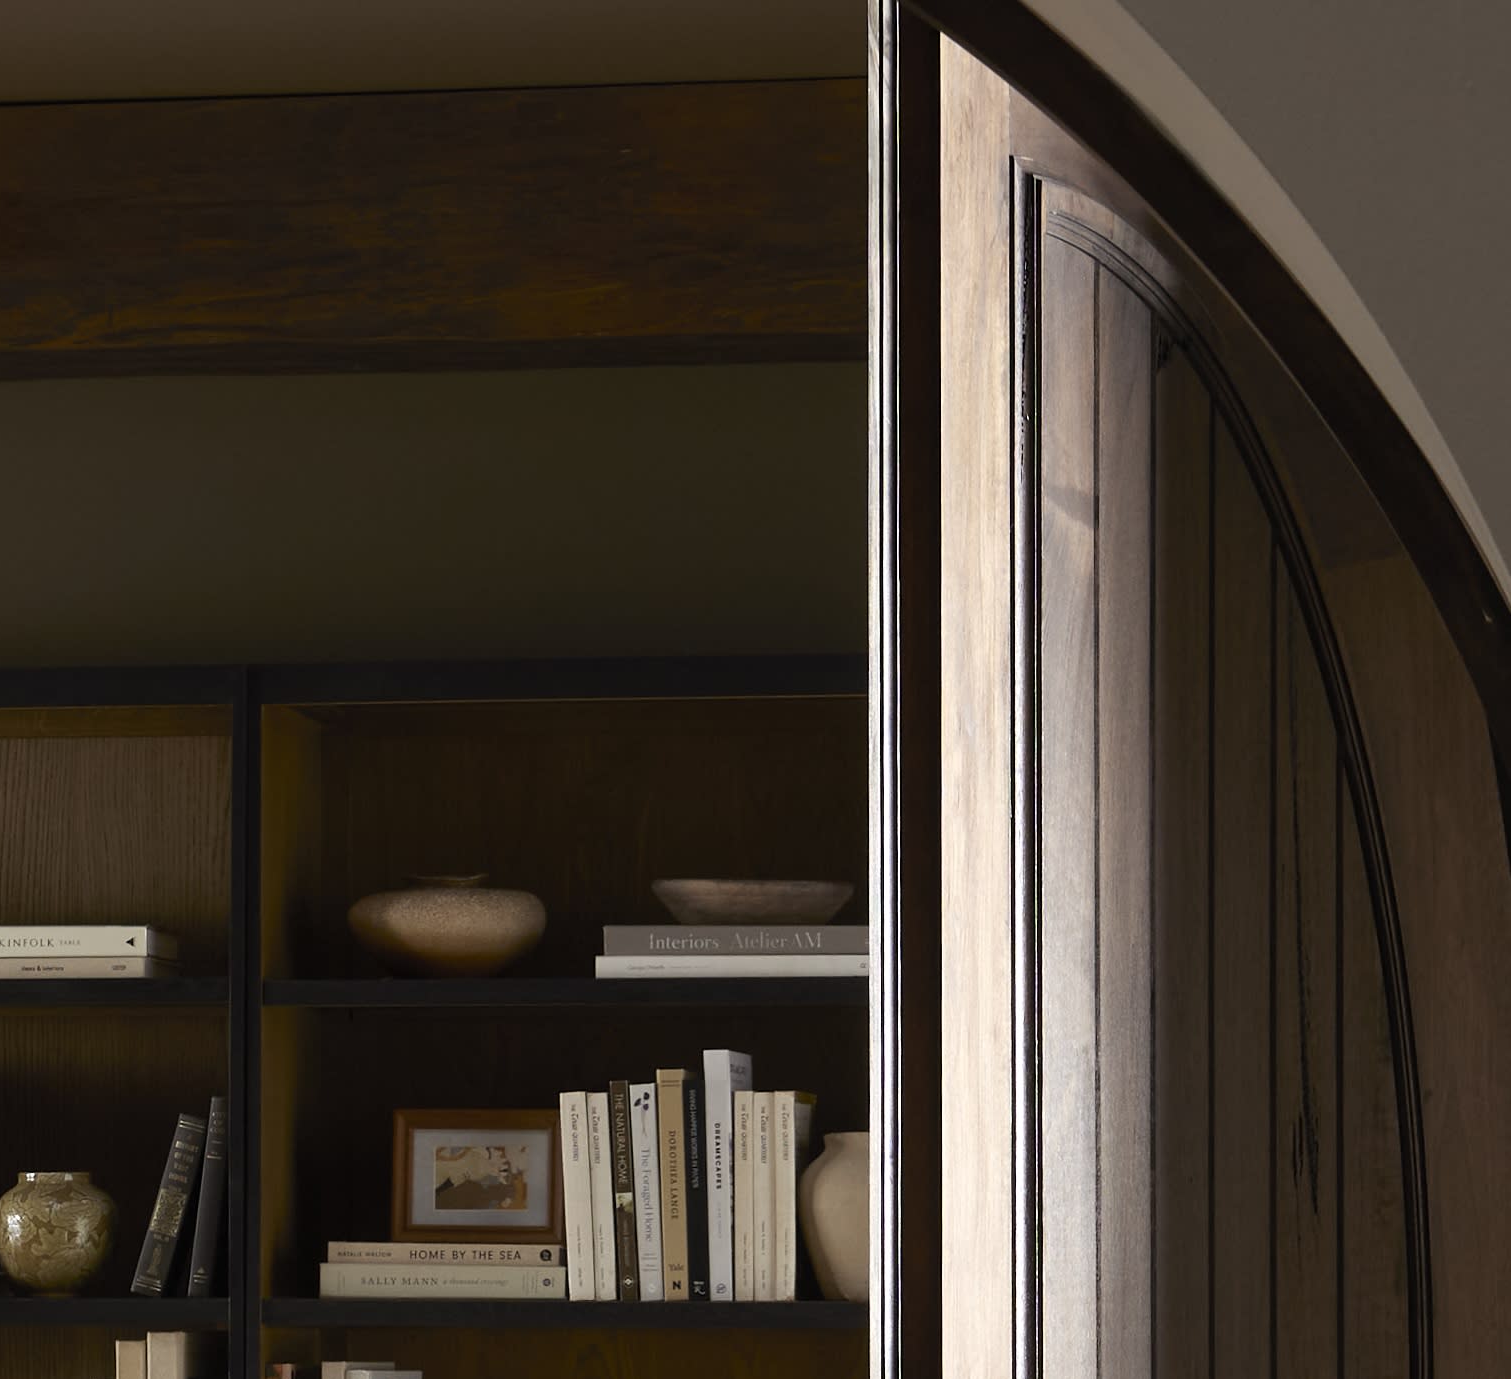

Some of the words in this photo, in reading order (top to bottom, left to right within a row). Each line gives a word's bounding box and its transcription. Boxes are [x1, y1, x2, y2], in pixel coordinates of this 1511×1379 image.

[648, 932, 720, 951] Interiors
[731, 932, 788, 951] Atelier
[615, 1093, 625, 1109] THE
[616, 1112, 627, 1155] NATURAL
[640, 1148, 651, 1166] The
[669, 1129, 678, 1185] DOROTHEA
[690, 1138, 698, 1159] WORKS
[713, 1122, 722, 1190] DREAMSCAPES
[618, 1156, 629, 1185] HOME
[691, 1168, 699, 1189] PAPER
[641, 1168, 654, 1210] Foraged
[670, 1187, 680, 1221] LANGE
[644, 1212, 654, 1243] Home
[409, 1249, 446, 1261] HOME
[452, 1249, 468, 1261] BY
[472, 1249, 495, 1261] THE
[499, 1249, 522, 1261] SEA
[360, 1276, 398, 1287] SALLY
[401, 1276, 439, 1287] MANN
